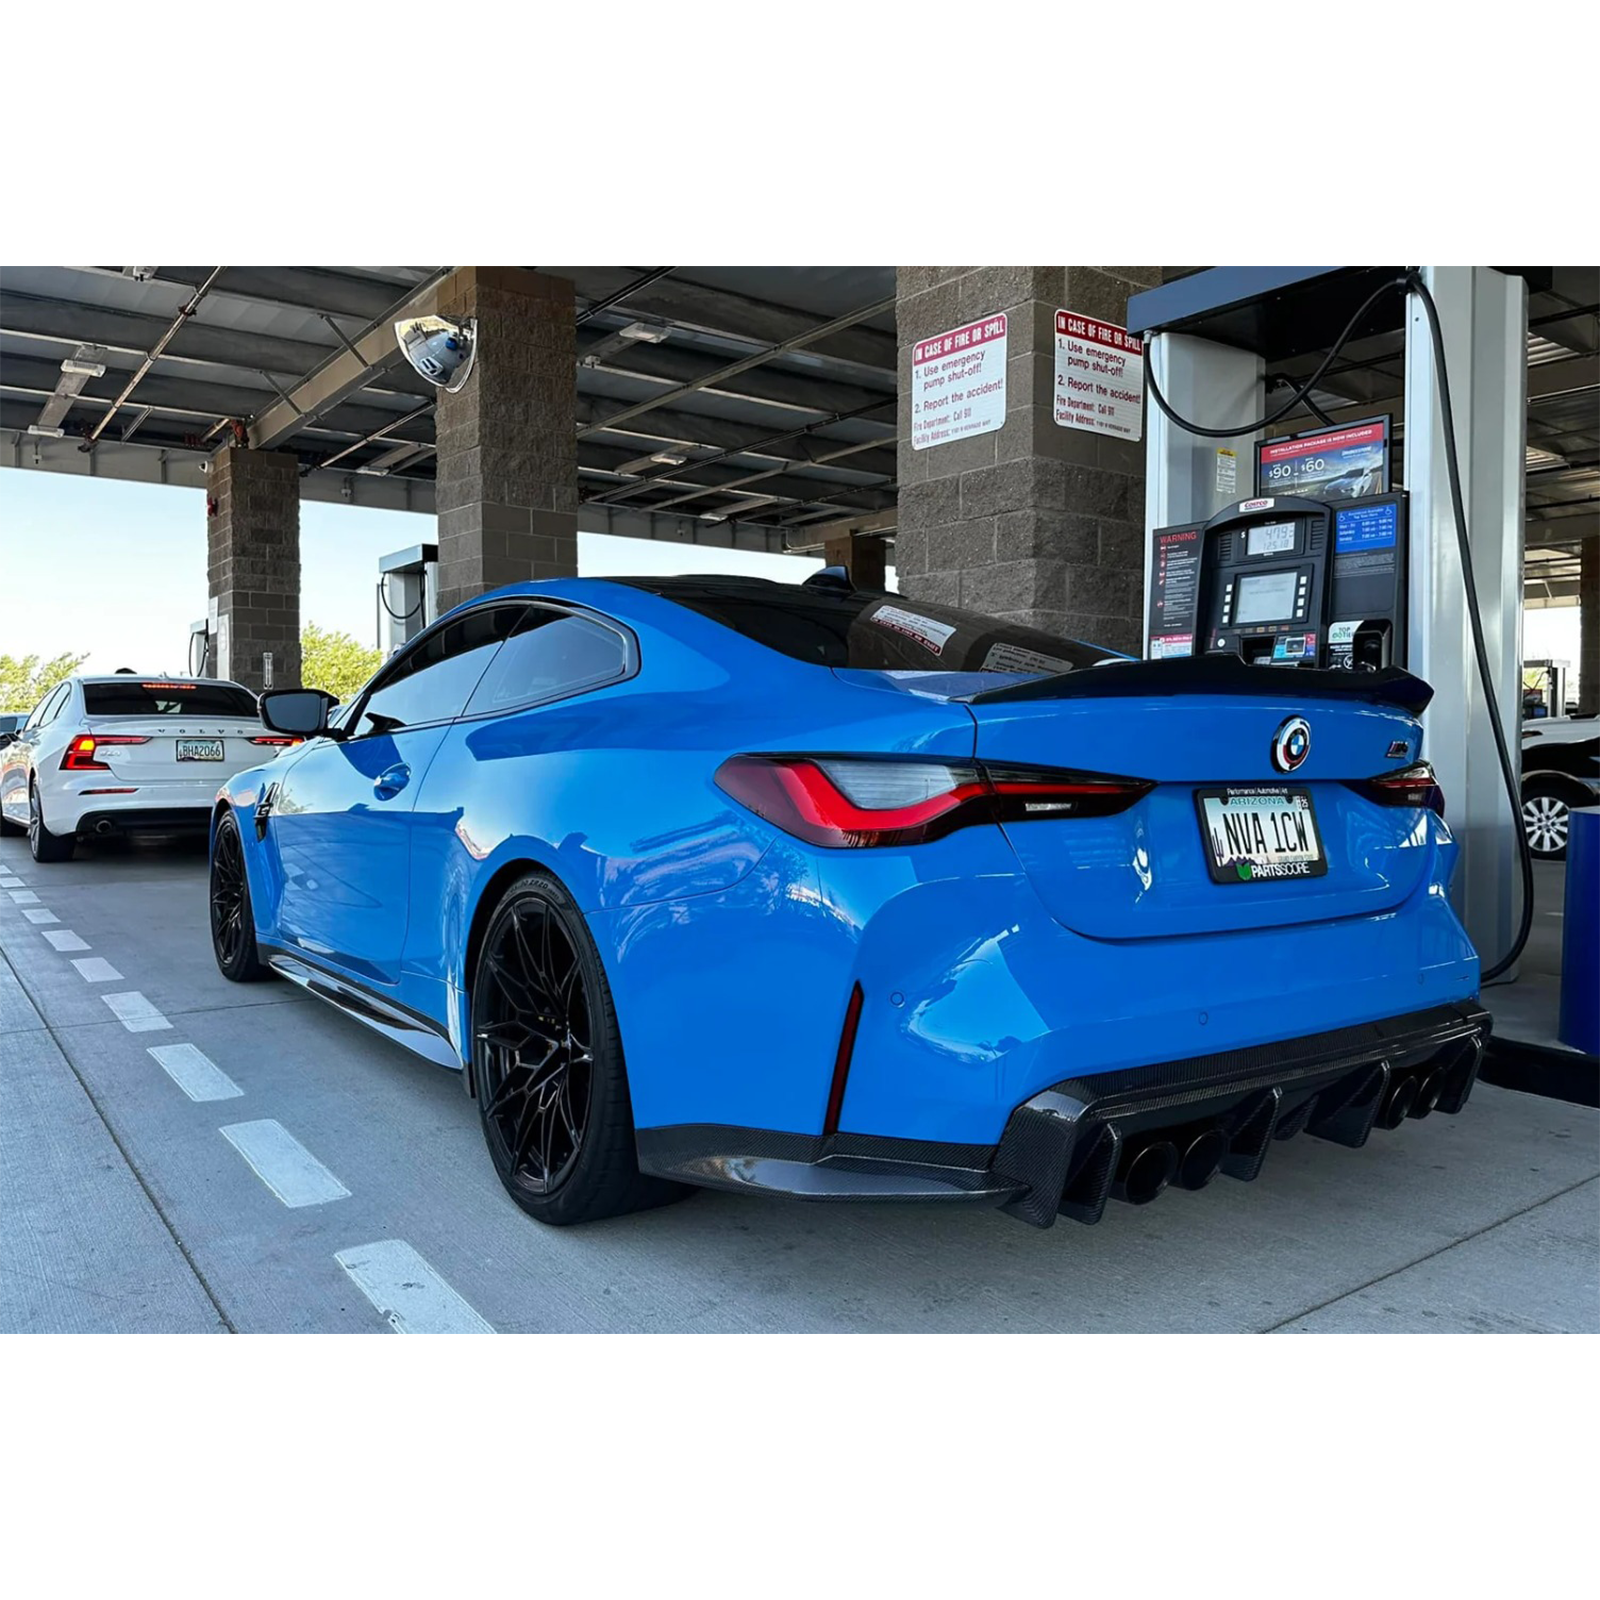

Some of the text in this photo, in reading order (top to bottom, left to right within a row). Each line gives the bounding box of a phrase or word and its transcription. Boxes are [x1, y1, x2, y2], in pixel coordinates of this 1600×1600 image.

[915, 319, 1004, 361] IN CASE OF FIRE OR SPILL
[1058, 315, 1141, 351] IN CASE OF FIRE OR SPILL
[915, 350, 986, 379] 1. Use emergency
[1058, 338, 1126, 367] 1. Use emergency
[1068, 356, 1090, 370] pump
[923, 362, 982, 392] pump shut-off!
[1058, 374, 1065, 386] 2.
[1068, 377, 1094, 392] Report
[1096, 384, 1108, 396] the
[914, 378, 1004, 414] 2. Report the accident!
[1056, 394, 1066, 406] Fire
[1098, 403, 1107, 414] Call
[953, 410, 962, 421] Call
[1268, 465, 1292, 478] $90
[1301, 458, 1325, 472] $60
[1160, 531, 1197, 544] WARNING
[1230, 797, 1284, 806] ARIZONA
[1222, 812, 1268, 855] NVA
